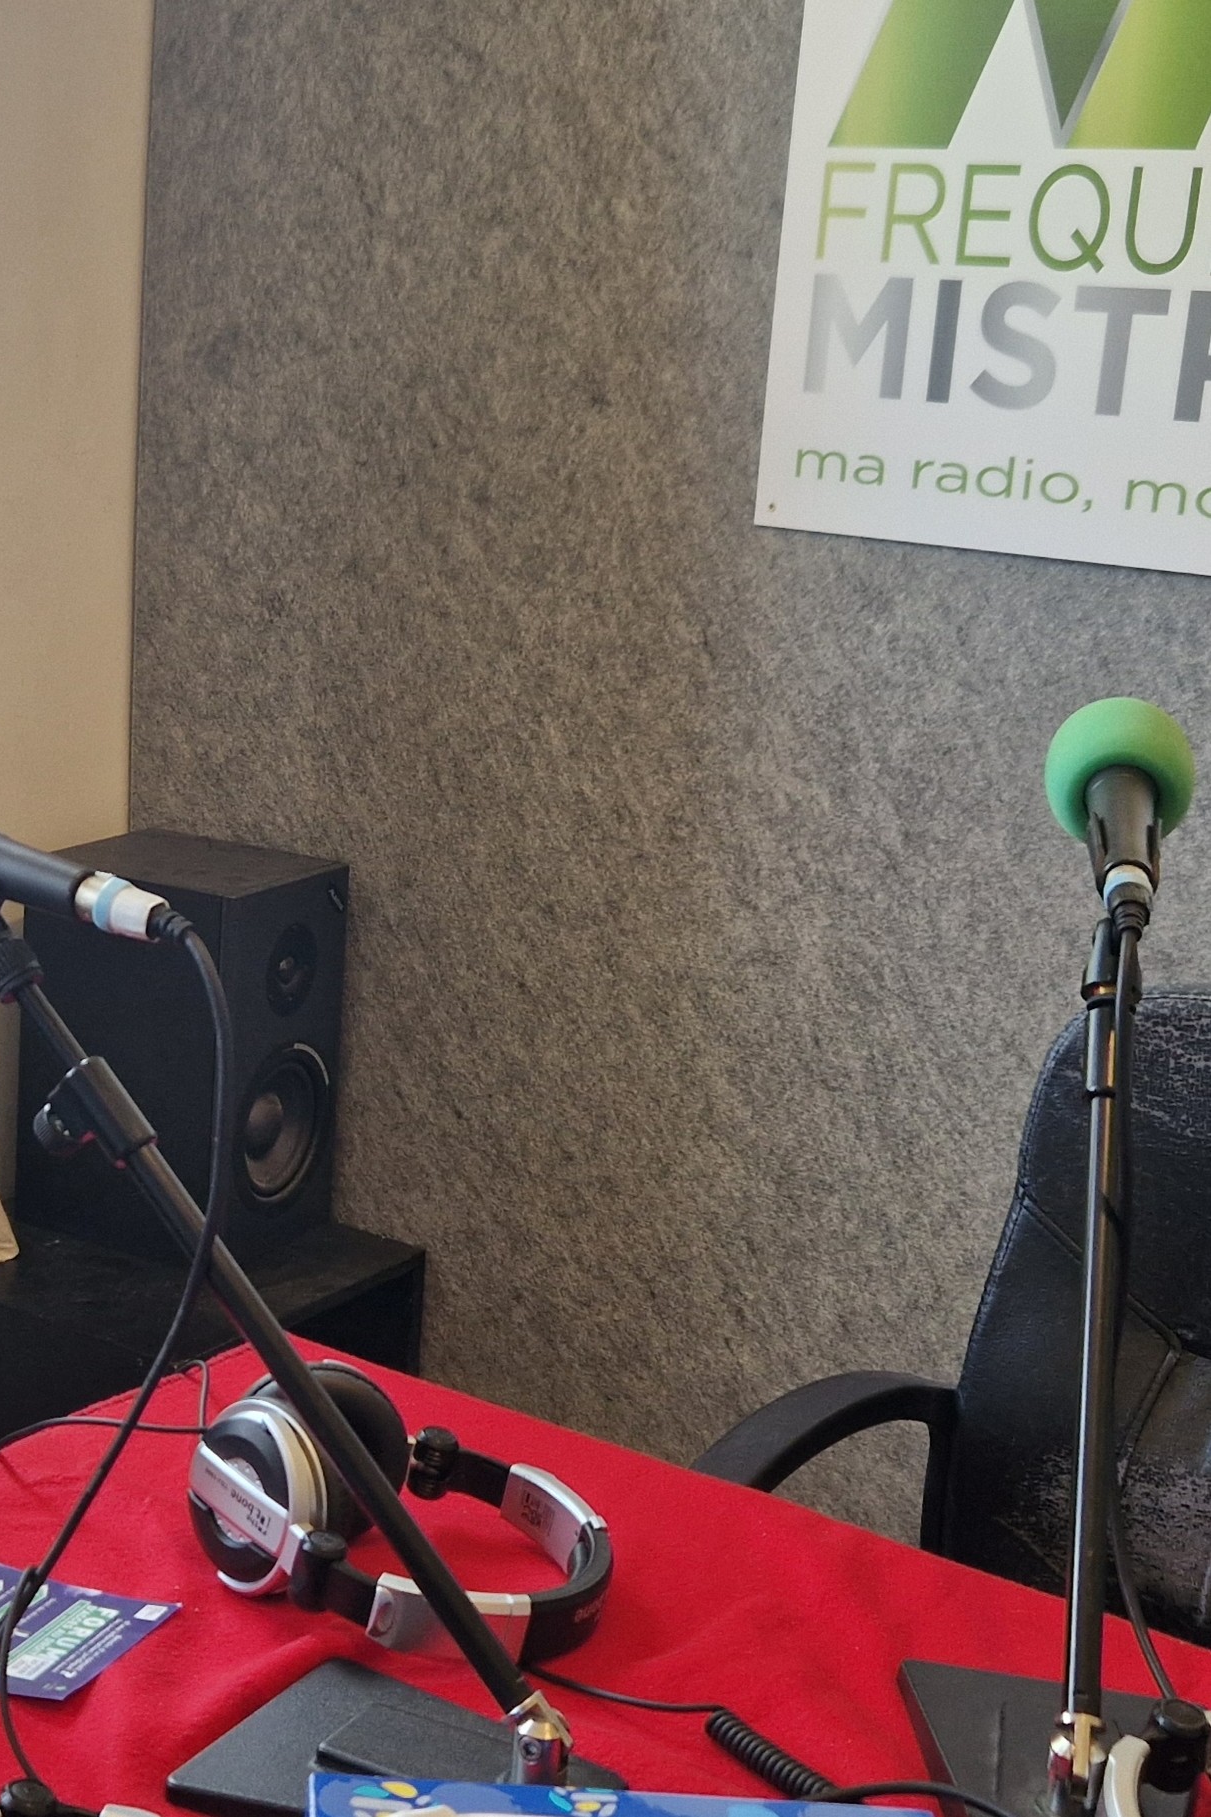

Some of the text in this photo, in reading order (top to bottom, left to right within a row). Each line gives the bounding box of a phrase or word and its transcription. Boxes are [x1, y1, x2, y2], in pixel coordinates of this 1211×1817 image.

[814, 160, 1211, 276] FREQU
[795, 448, 886, 487] ma
[912, 455, 1093, 513] radio,
[35, 1606, 120, 1661] FORUM
